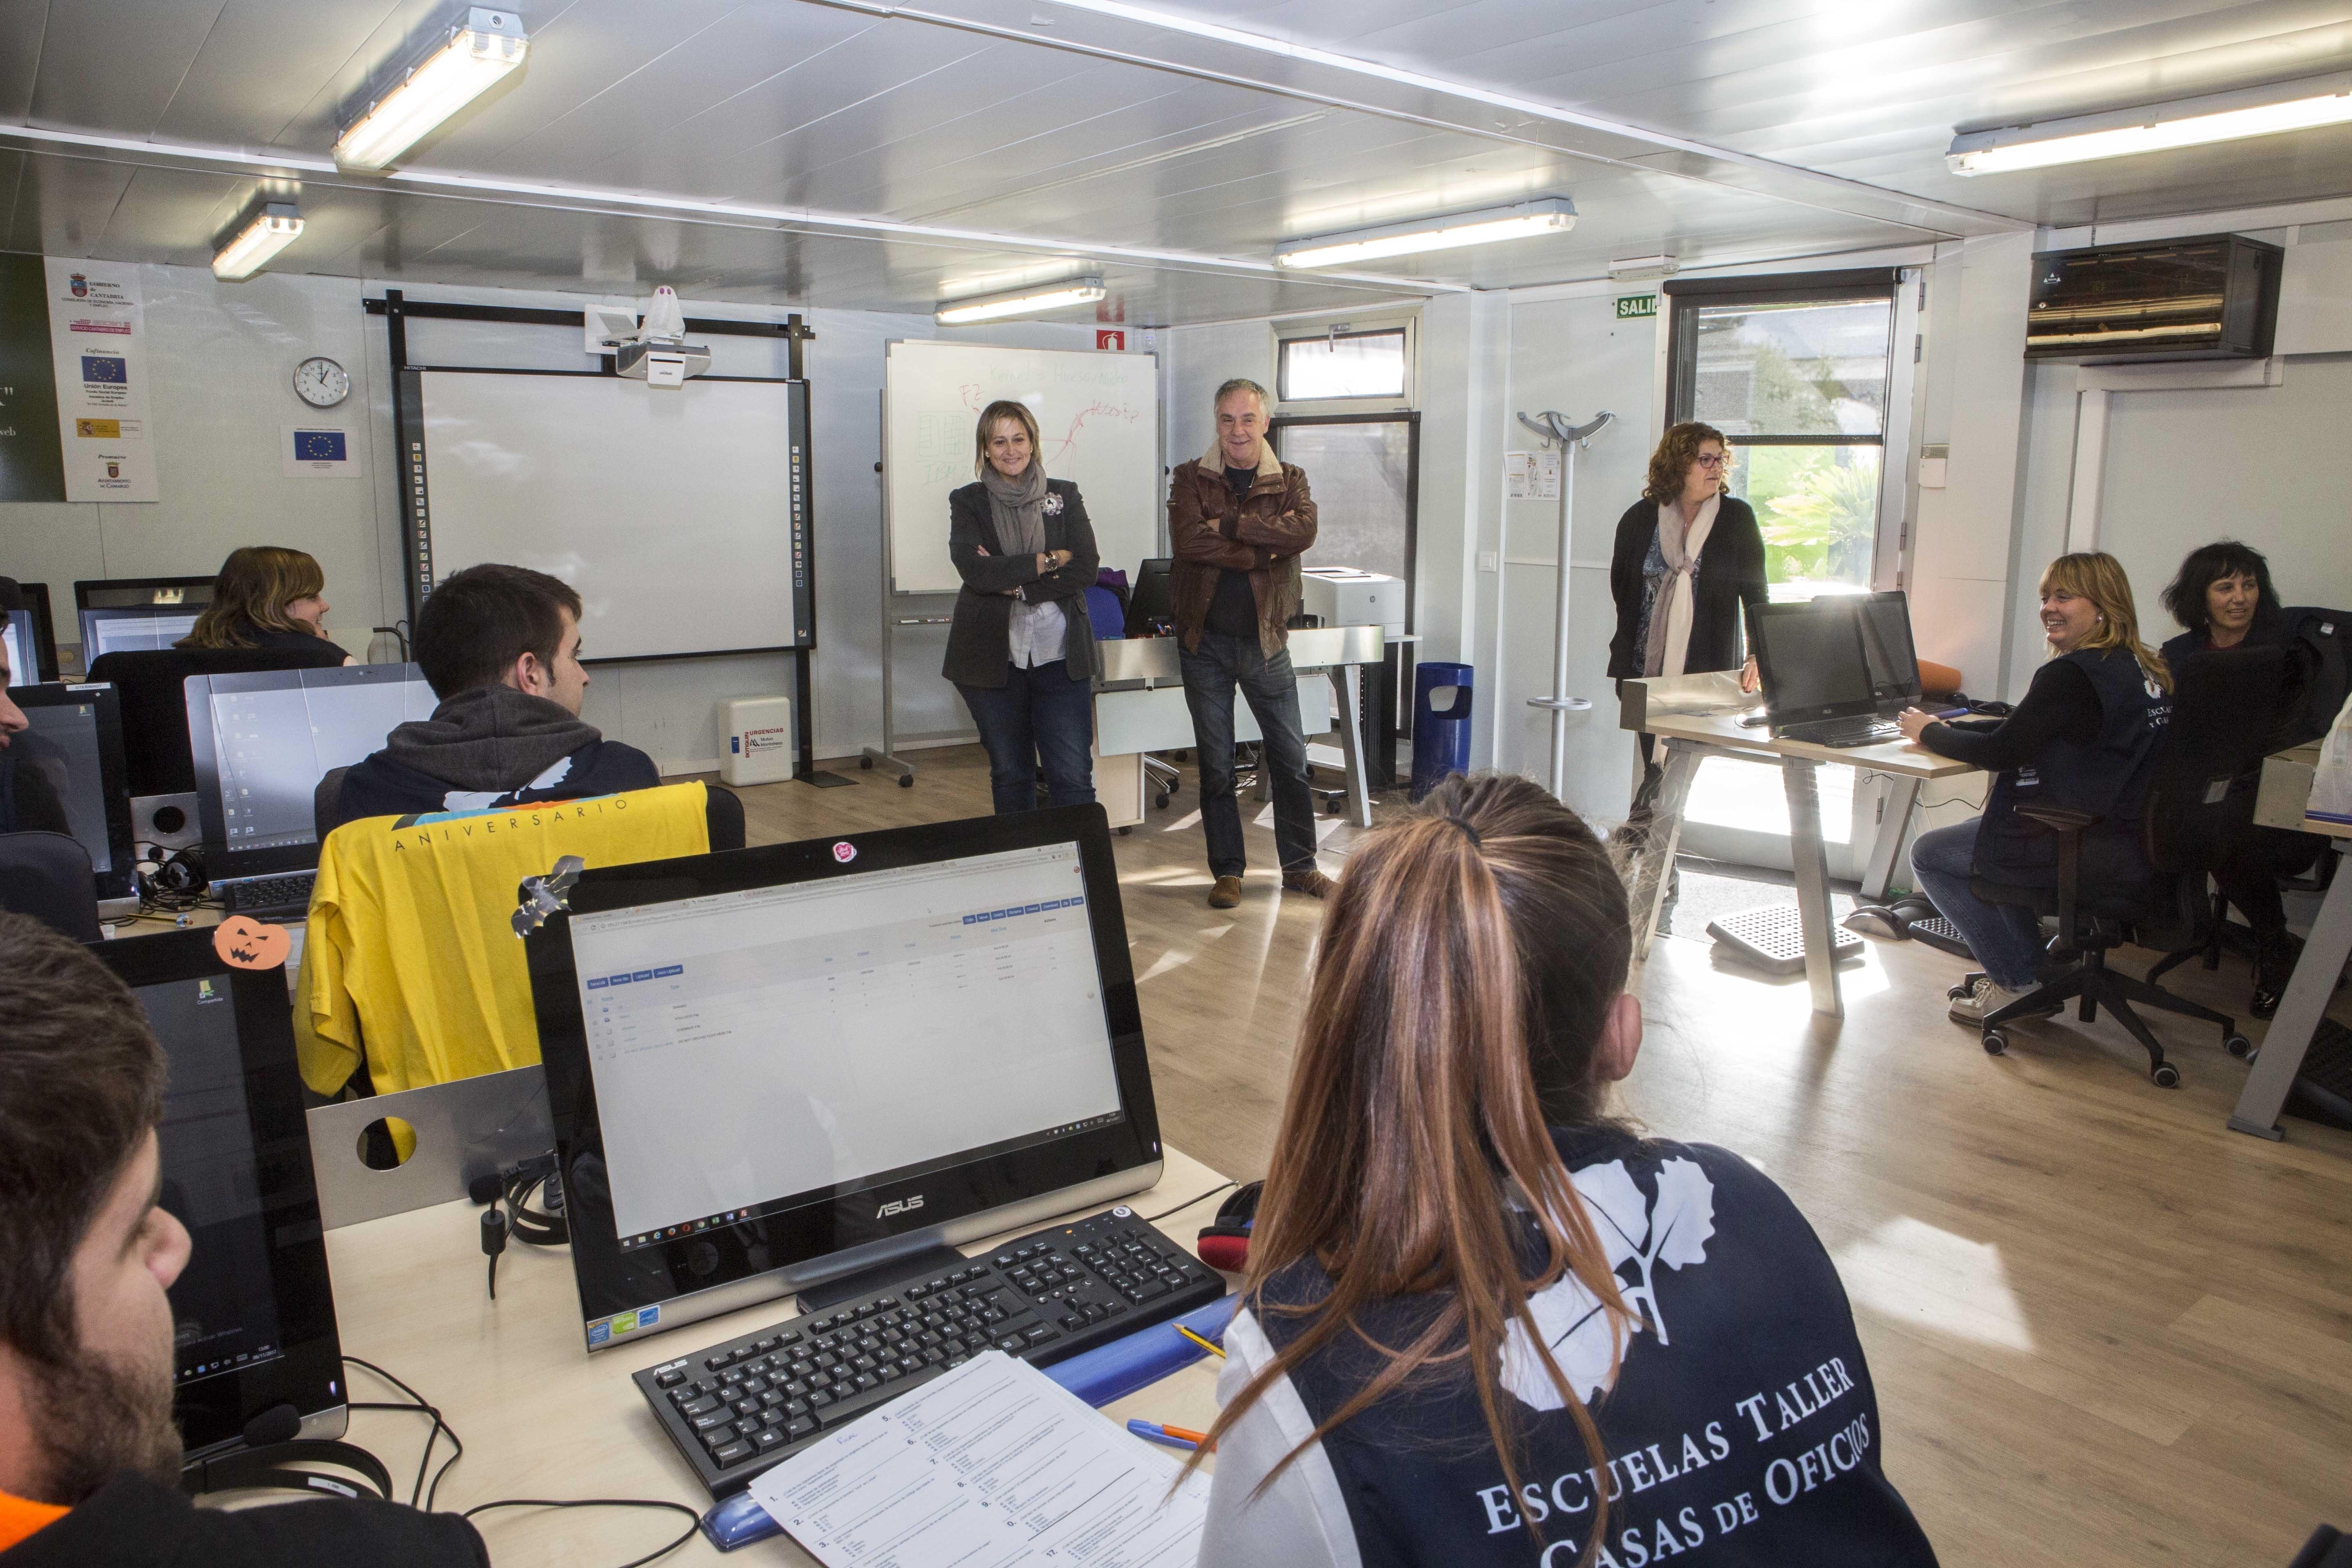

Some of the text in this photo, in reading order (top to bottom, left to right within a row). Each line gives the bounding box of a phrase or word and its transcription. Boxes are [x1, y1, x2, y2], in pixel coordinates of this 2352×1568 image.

[749, 727, 784, 736] URGENCIAS
[394, 799, 627, 853] ANIVERSARIO
[876, 1194, 924, 1219] ASUS
[593, 1325, 606, 1334] intel
[1028, 1328, 1044, 1337] Control
[653, 1359, 688, 1376] ASUS
[1476, 1357, 1855, 1534] ESCUELAS TALLER
[720, 1448, 738, 1457] Control
[1540, 1412, 1870, 1568] CASAS DE OFICIOS
[1046, 1549, 1058, 1558] 17.
